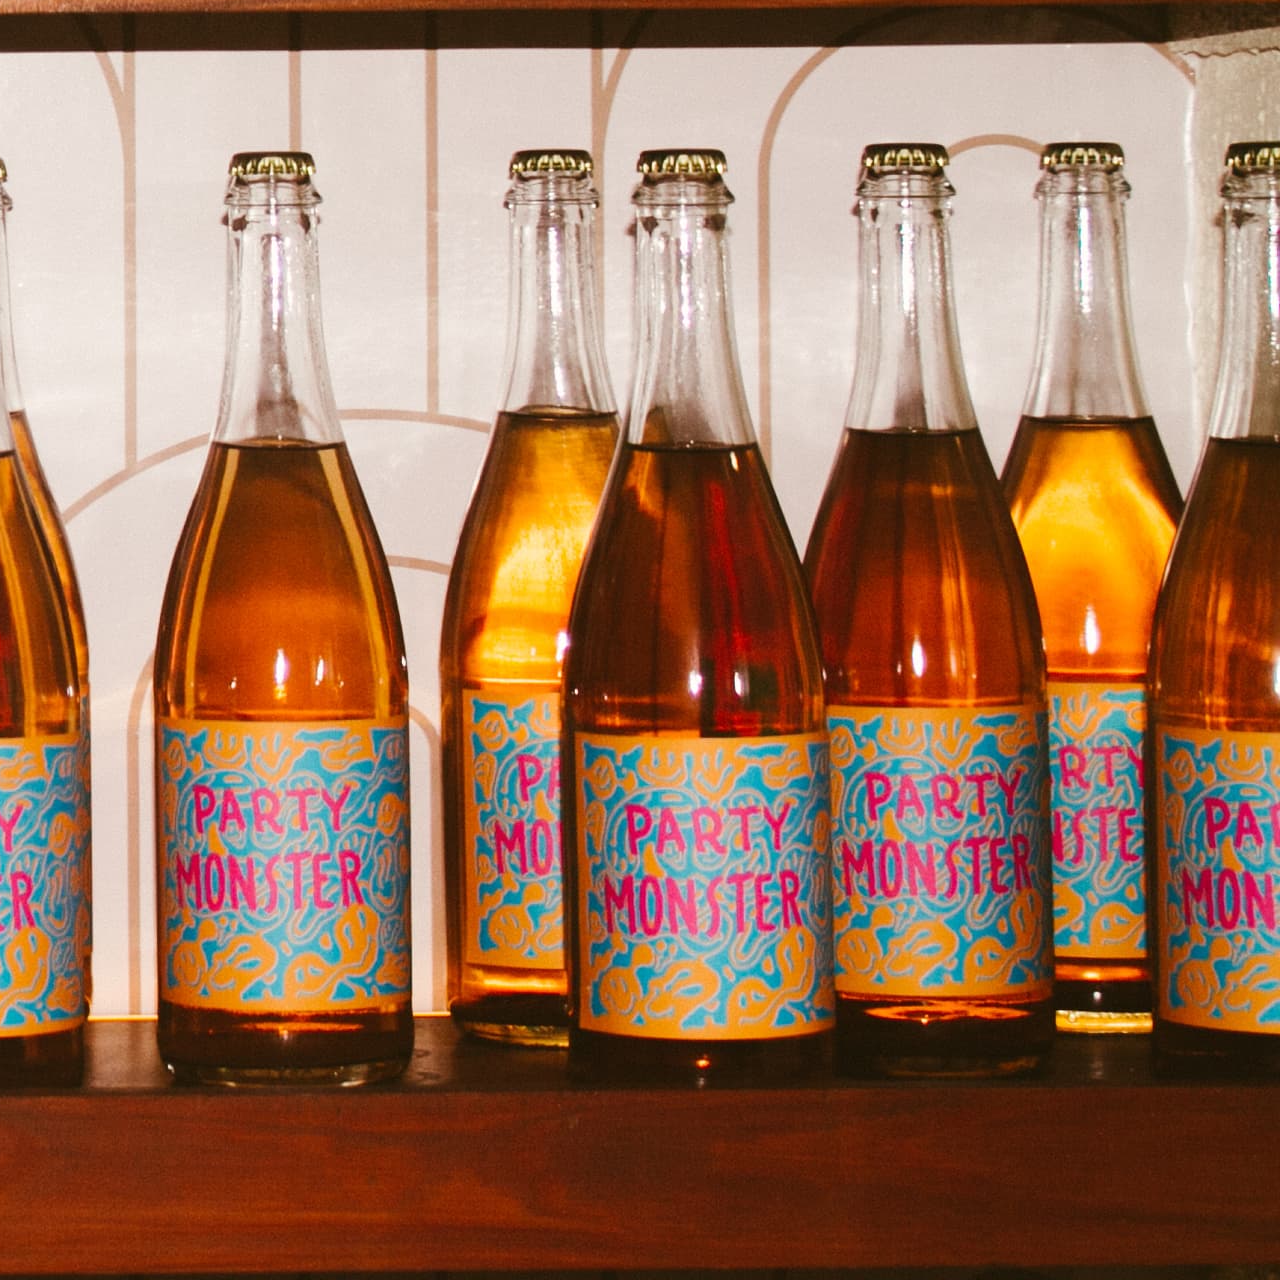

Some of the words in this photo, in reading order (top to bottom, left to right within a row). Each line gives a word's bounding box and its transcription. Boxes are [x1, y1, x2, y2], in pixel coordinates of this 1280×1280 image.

[192, 783, 352, 834] PARTY
[864, 770, 1024, 821] PARTY
[624, 802, 792, 857] PARTY
[175, 849, 365, 915] MONSTER
[841, 834, 1034, 900] MONSTER
[602, 869, 804, 939] MONSTER
